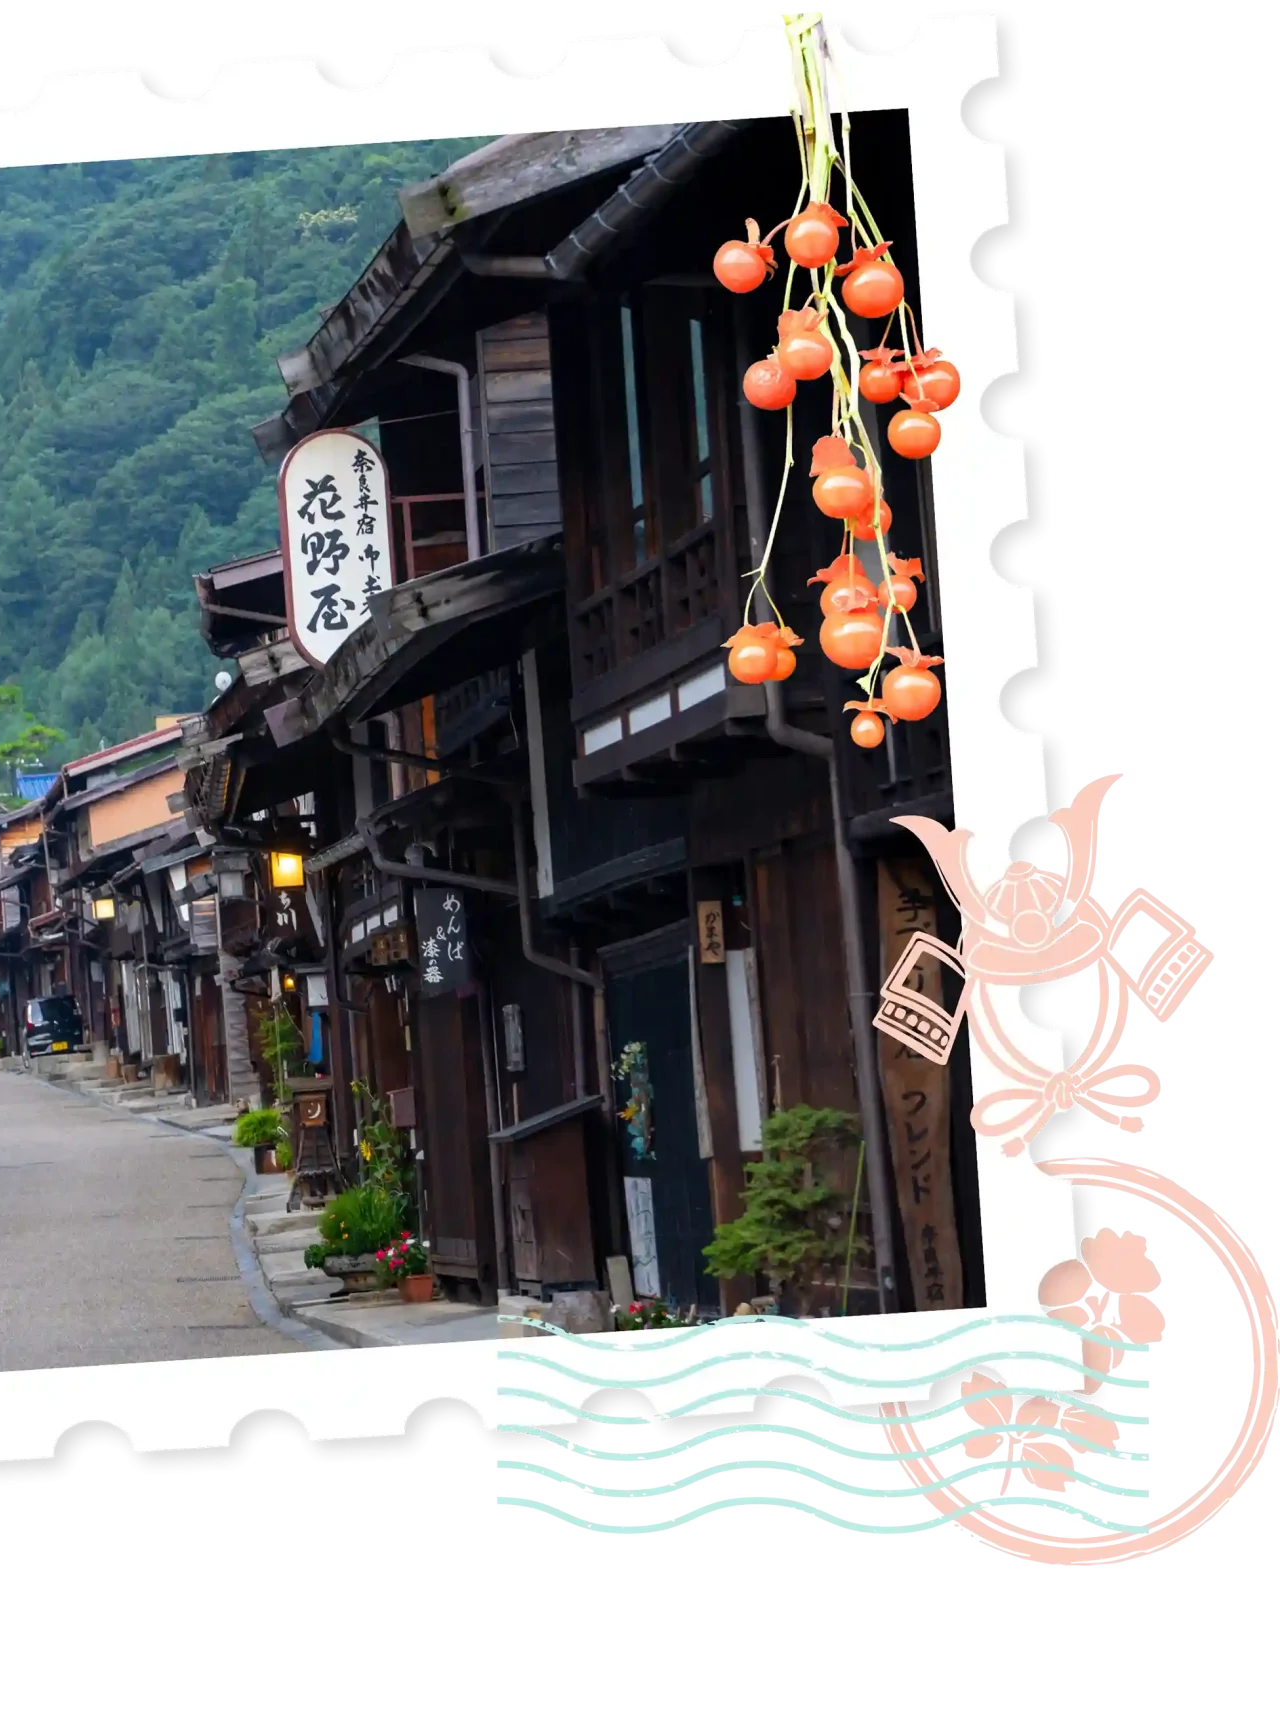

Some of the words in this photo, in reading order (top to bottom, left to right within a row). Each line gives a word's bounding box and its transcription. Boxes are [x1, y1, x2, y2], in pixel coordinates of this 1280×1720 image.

[351, 448, 379, 537] 奈良井宿
[297, 474, 356, 634] 花野屋
[421, 935, 445, 984] 漆の器
[436, 926, 447, 940] &
